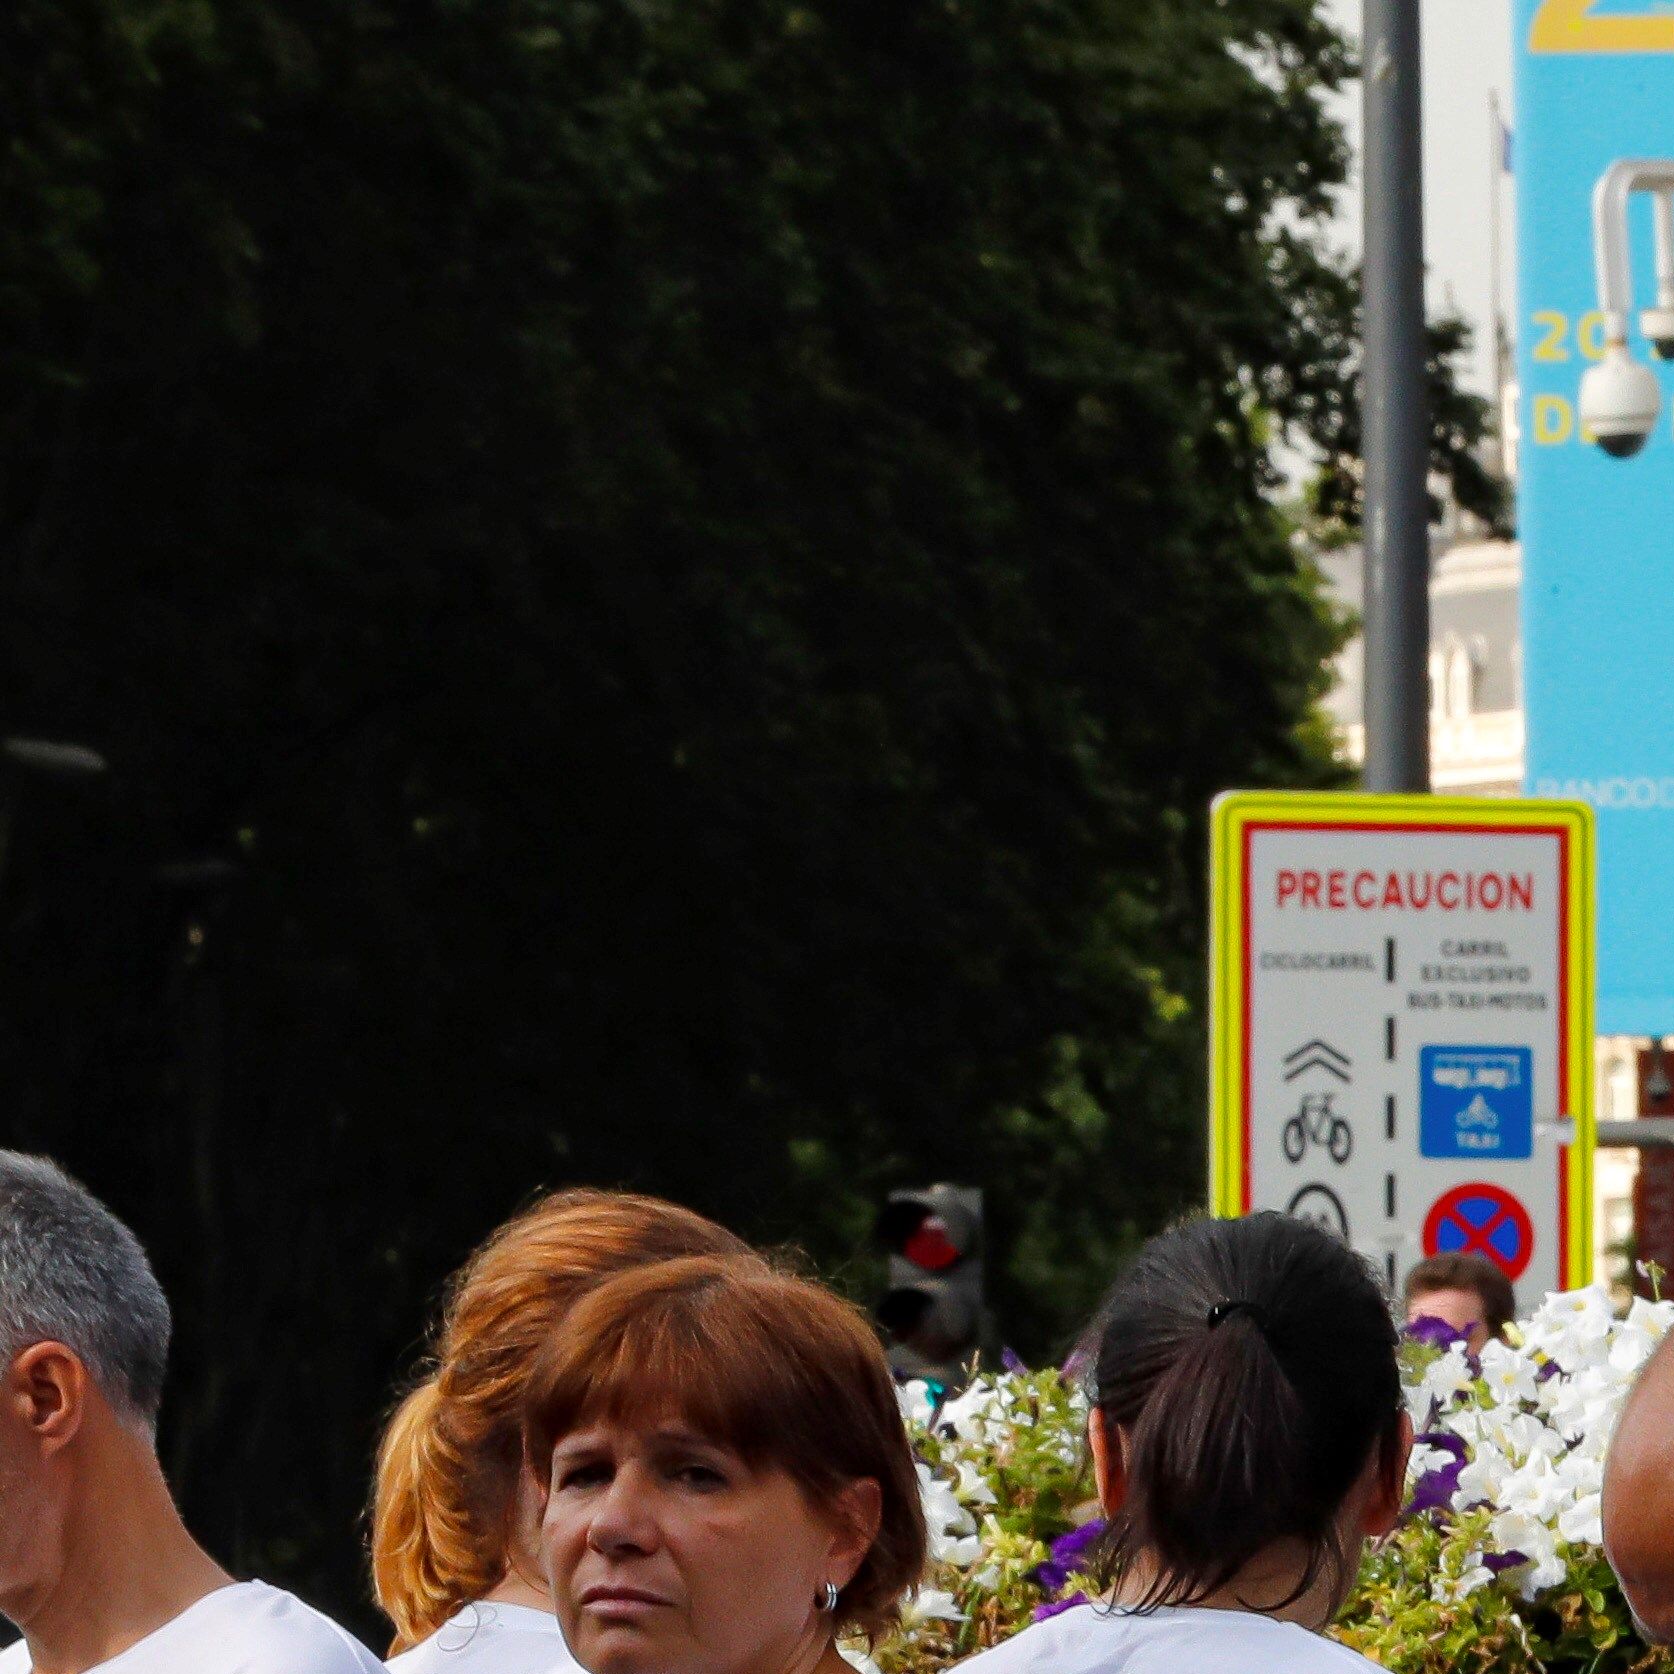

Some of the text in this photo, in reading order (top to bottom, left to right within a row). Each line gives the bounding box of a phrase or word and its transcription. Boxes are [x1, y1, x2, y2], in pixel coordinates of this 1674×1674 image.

[1277, 868, 1535, 911] PRECAUCION
[1440, 939, 1507, 958] CARRIL
[1421, 964, 1531, 984] EXCLUSIVO
